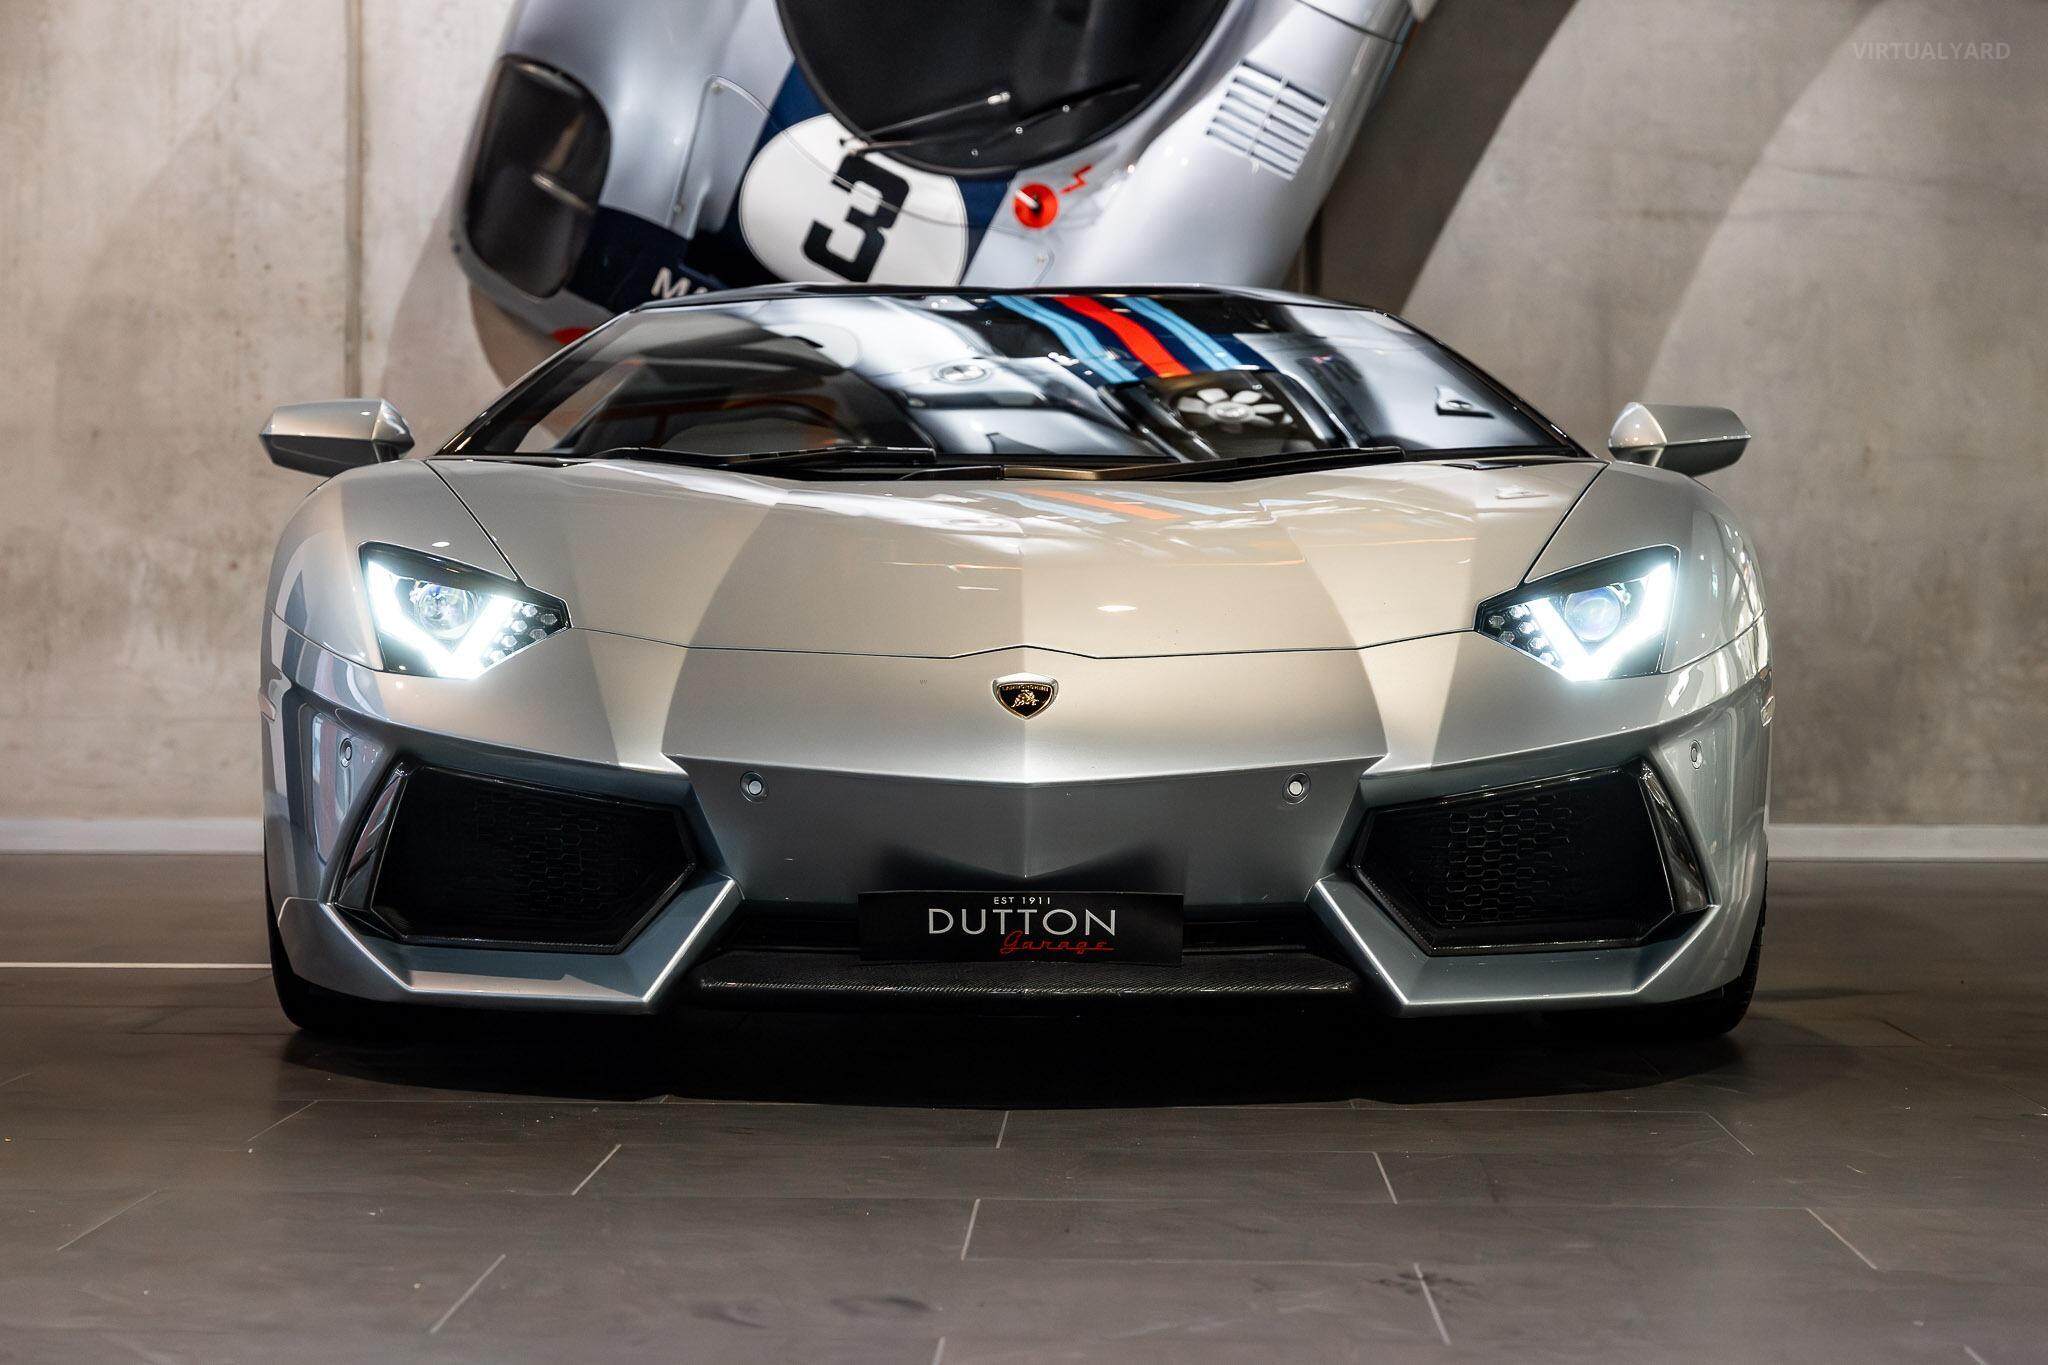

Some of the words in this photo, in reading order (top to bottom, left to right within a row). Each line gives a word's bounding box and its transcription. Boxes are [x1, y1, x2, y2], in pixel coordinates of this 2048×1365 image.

[803, 154, 910, 282] 3
[993, 896, 1014, 905] EST
[1022, 896, 1051, 905] 1911
[928, 908, 1116, 936] DUTTON
[1000, 930, 1115, 955] Garage
